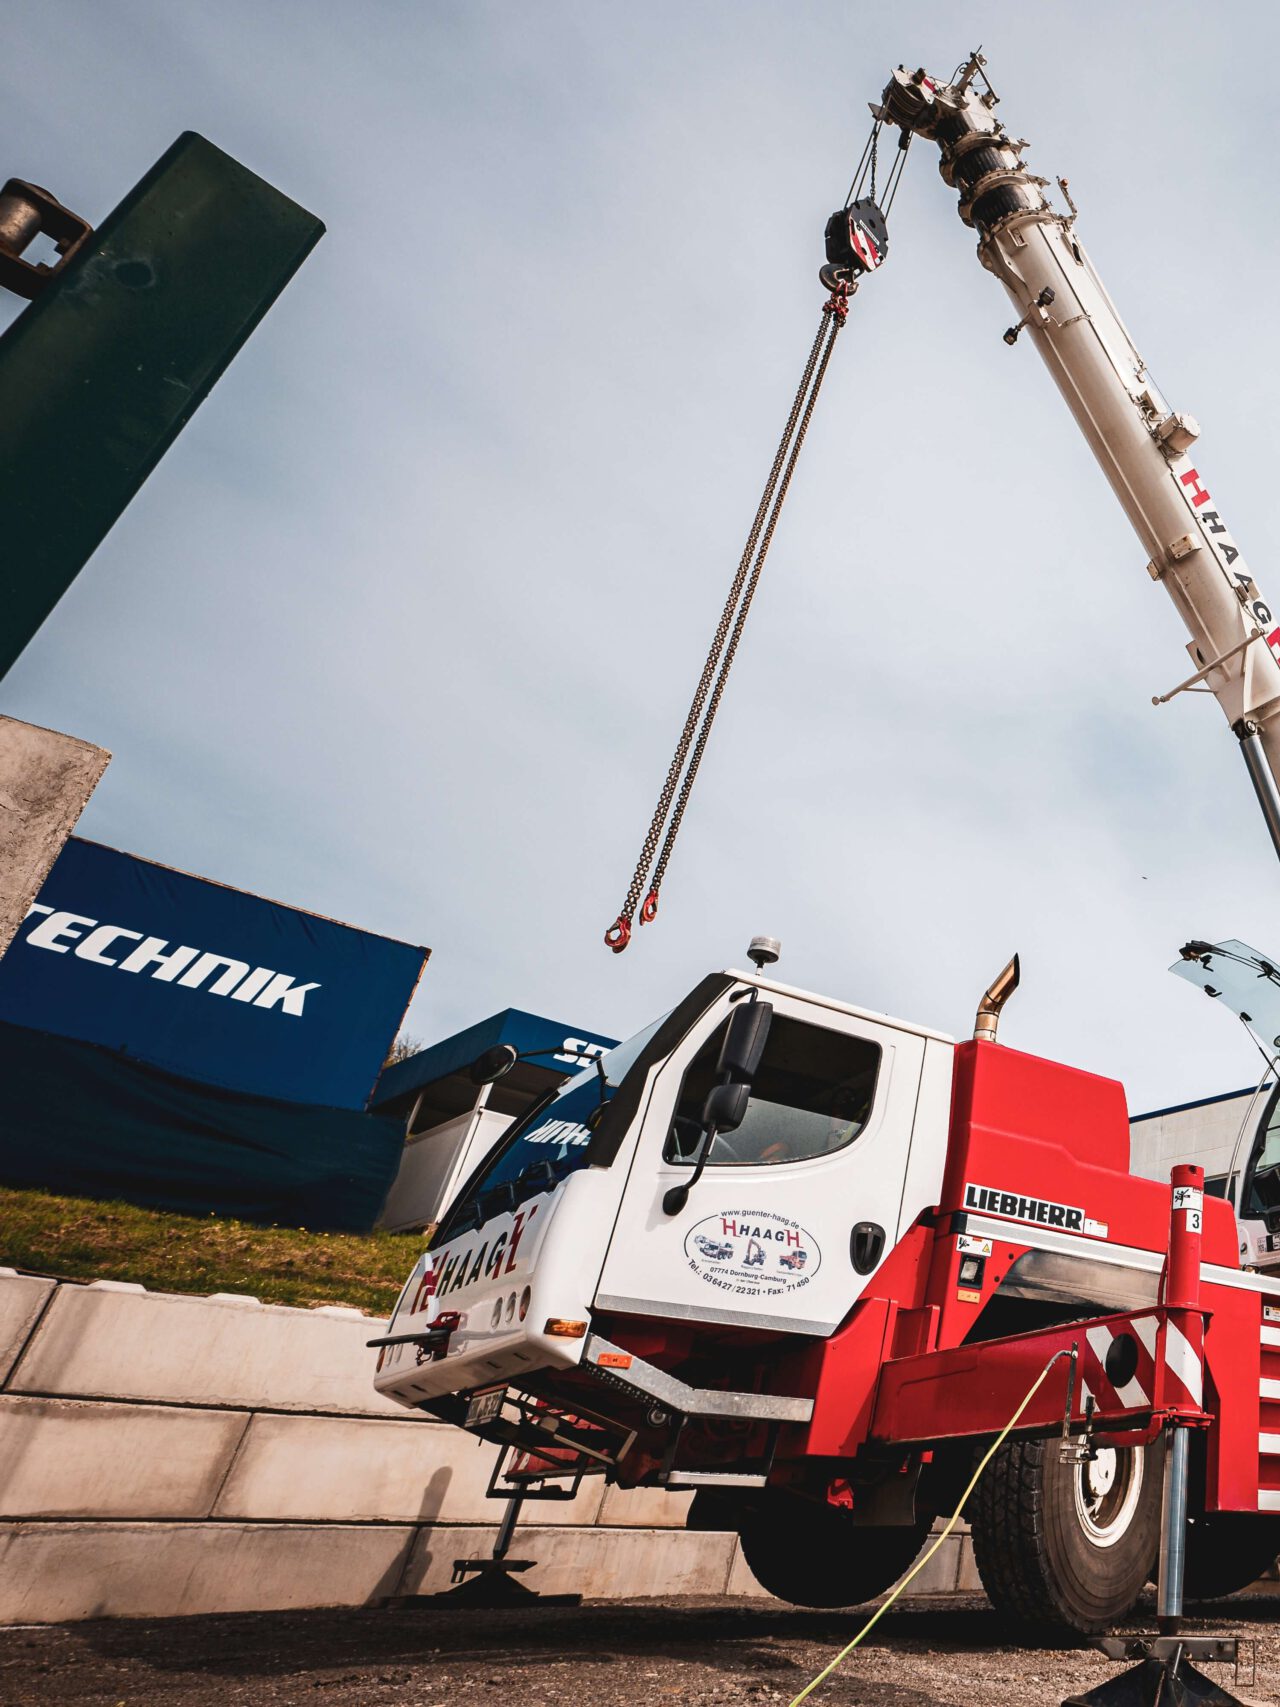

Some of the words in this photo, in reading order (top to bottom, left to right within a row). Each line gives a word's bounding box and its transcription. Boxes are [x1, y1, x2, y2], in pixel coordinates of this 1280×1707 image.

[720, 1209, 800, 1230] www.guenter-haag.de
[965, 1185, 1084, 1232] LIEBHERR
[1192, 1213, 1200, 1229] 3
[688, 1259, 702, 1275] Tel.:
[767, 1287, 784, 1296] Fax:
